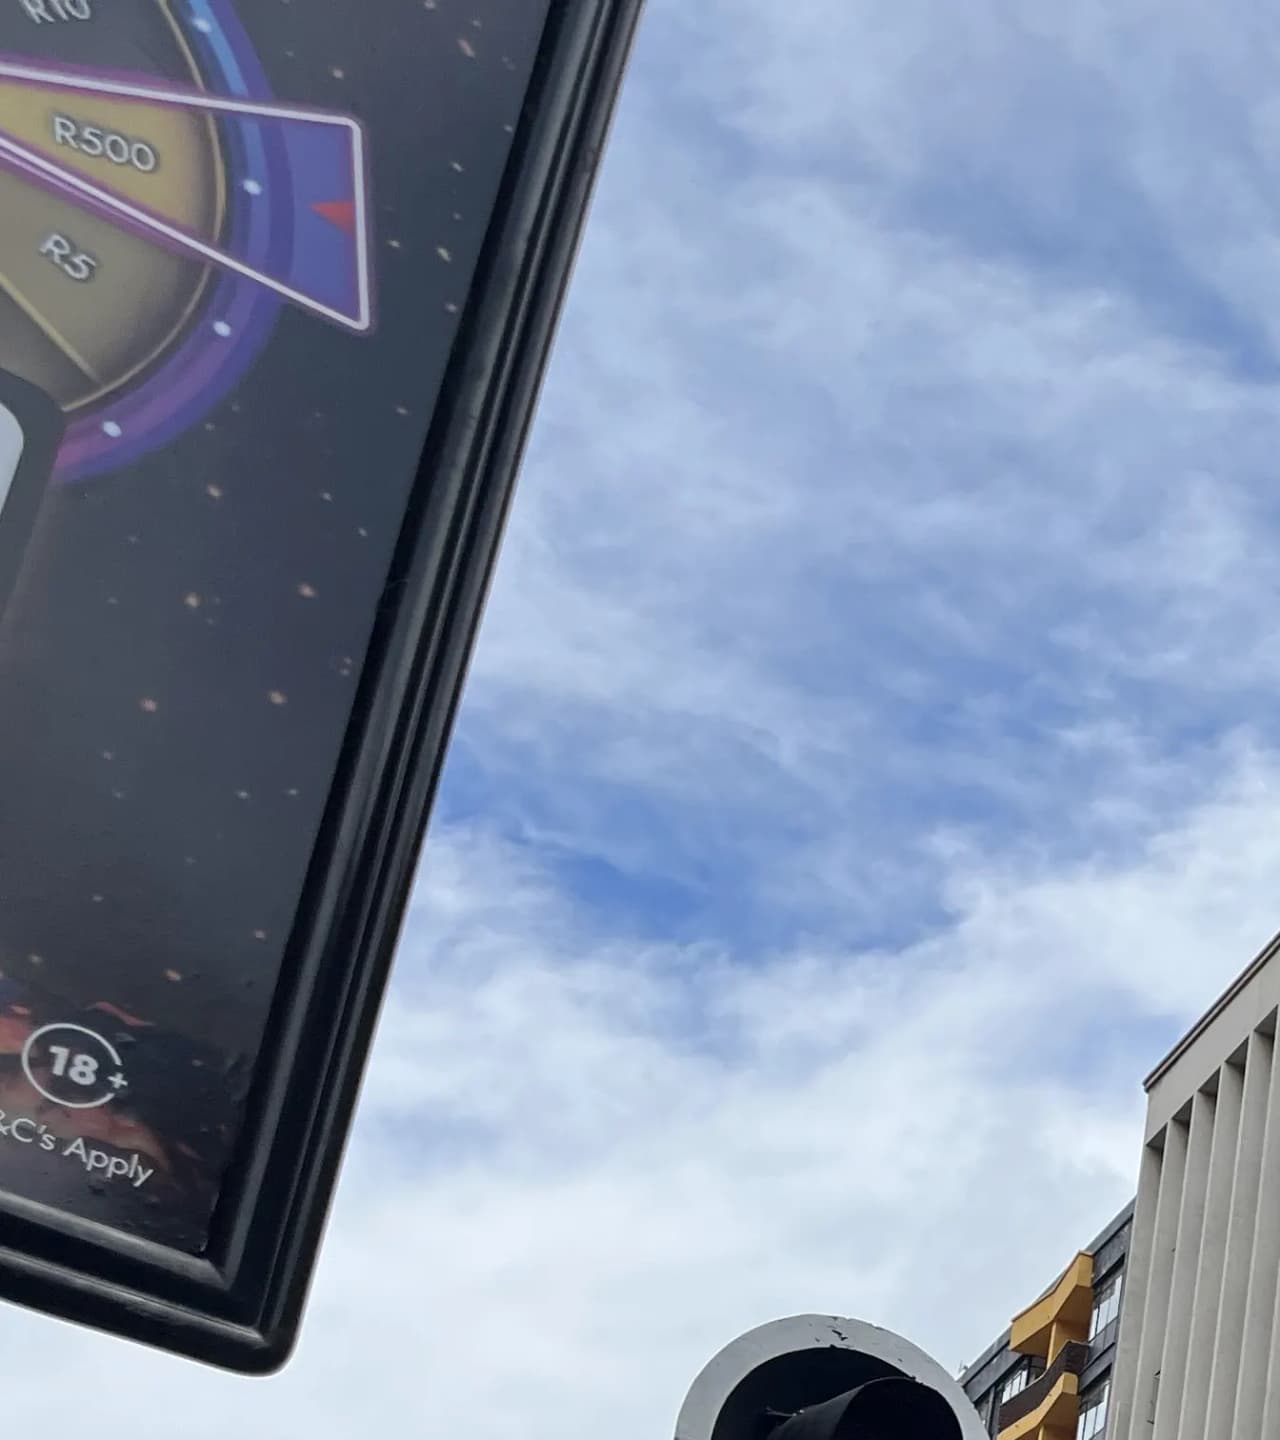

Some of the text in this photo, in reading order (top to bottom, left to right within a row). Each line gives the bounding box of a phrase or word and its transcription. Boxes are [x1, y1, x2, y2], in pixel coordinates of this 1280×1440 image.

[53, 117, 156, 173] R500
[40, 233, 96, 281] R5
[48, 1045, 128, 1089] 18+
[0, 1108, 154, 1187] C's Apply
